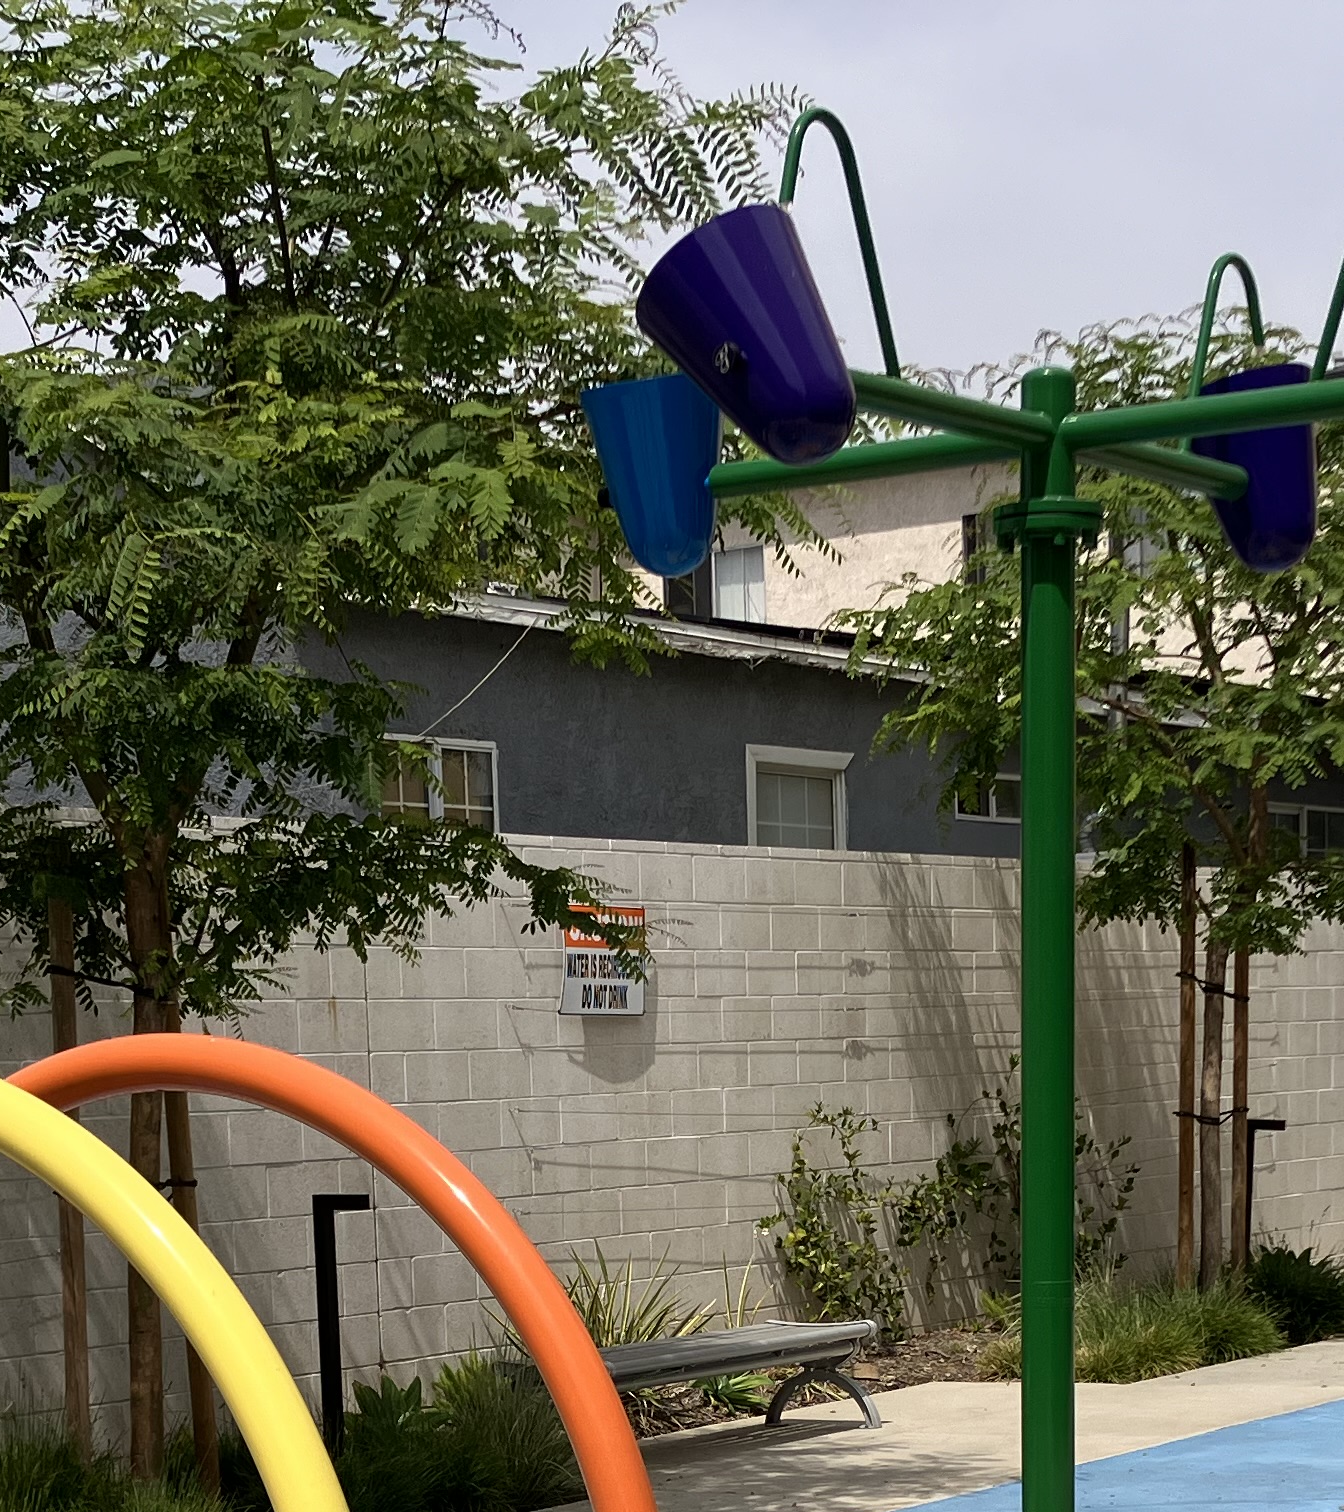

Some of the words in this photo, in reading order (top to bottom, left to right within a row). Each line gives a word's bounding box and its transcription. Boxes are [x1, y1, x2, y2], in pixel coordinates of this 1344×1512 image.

[567, 954, 590, 978] WATER
[590, 954, 597, 979] IS
[582, 984, 592, 1009] DO
[593, 984, 607, 1009] NOT
[608, 984, 629, 1009] DRINK
